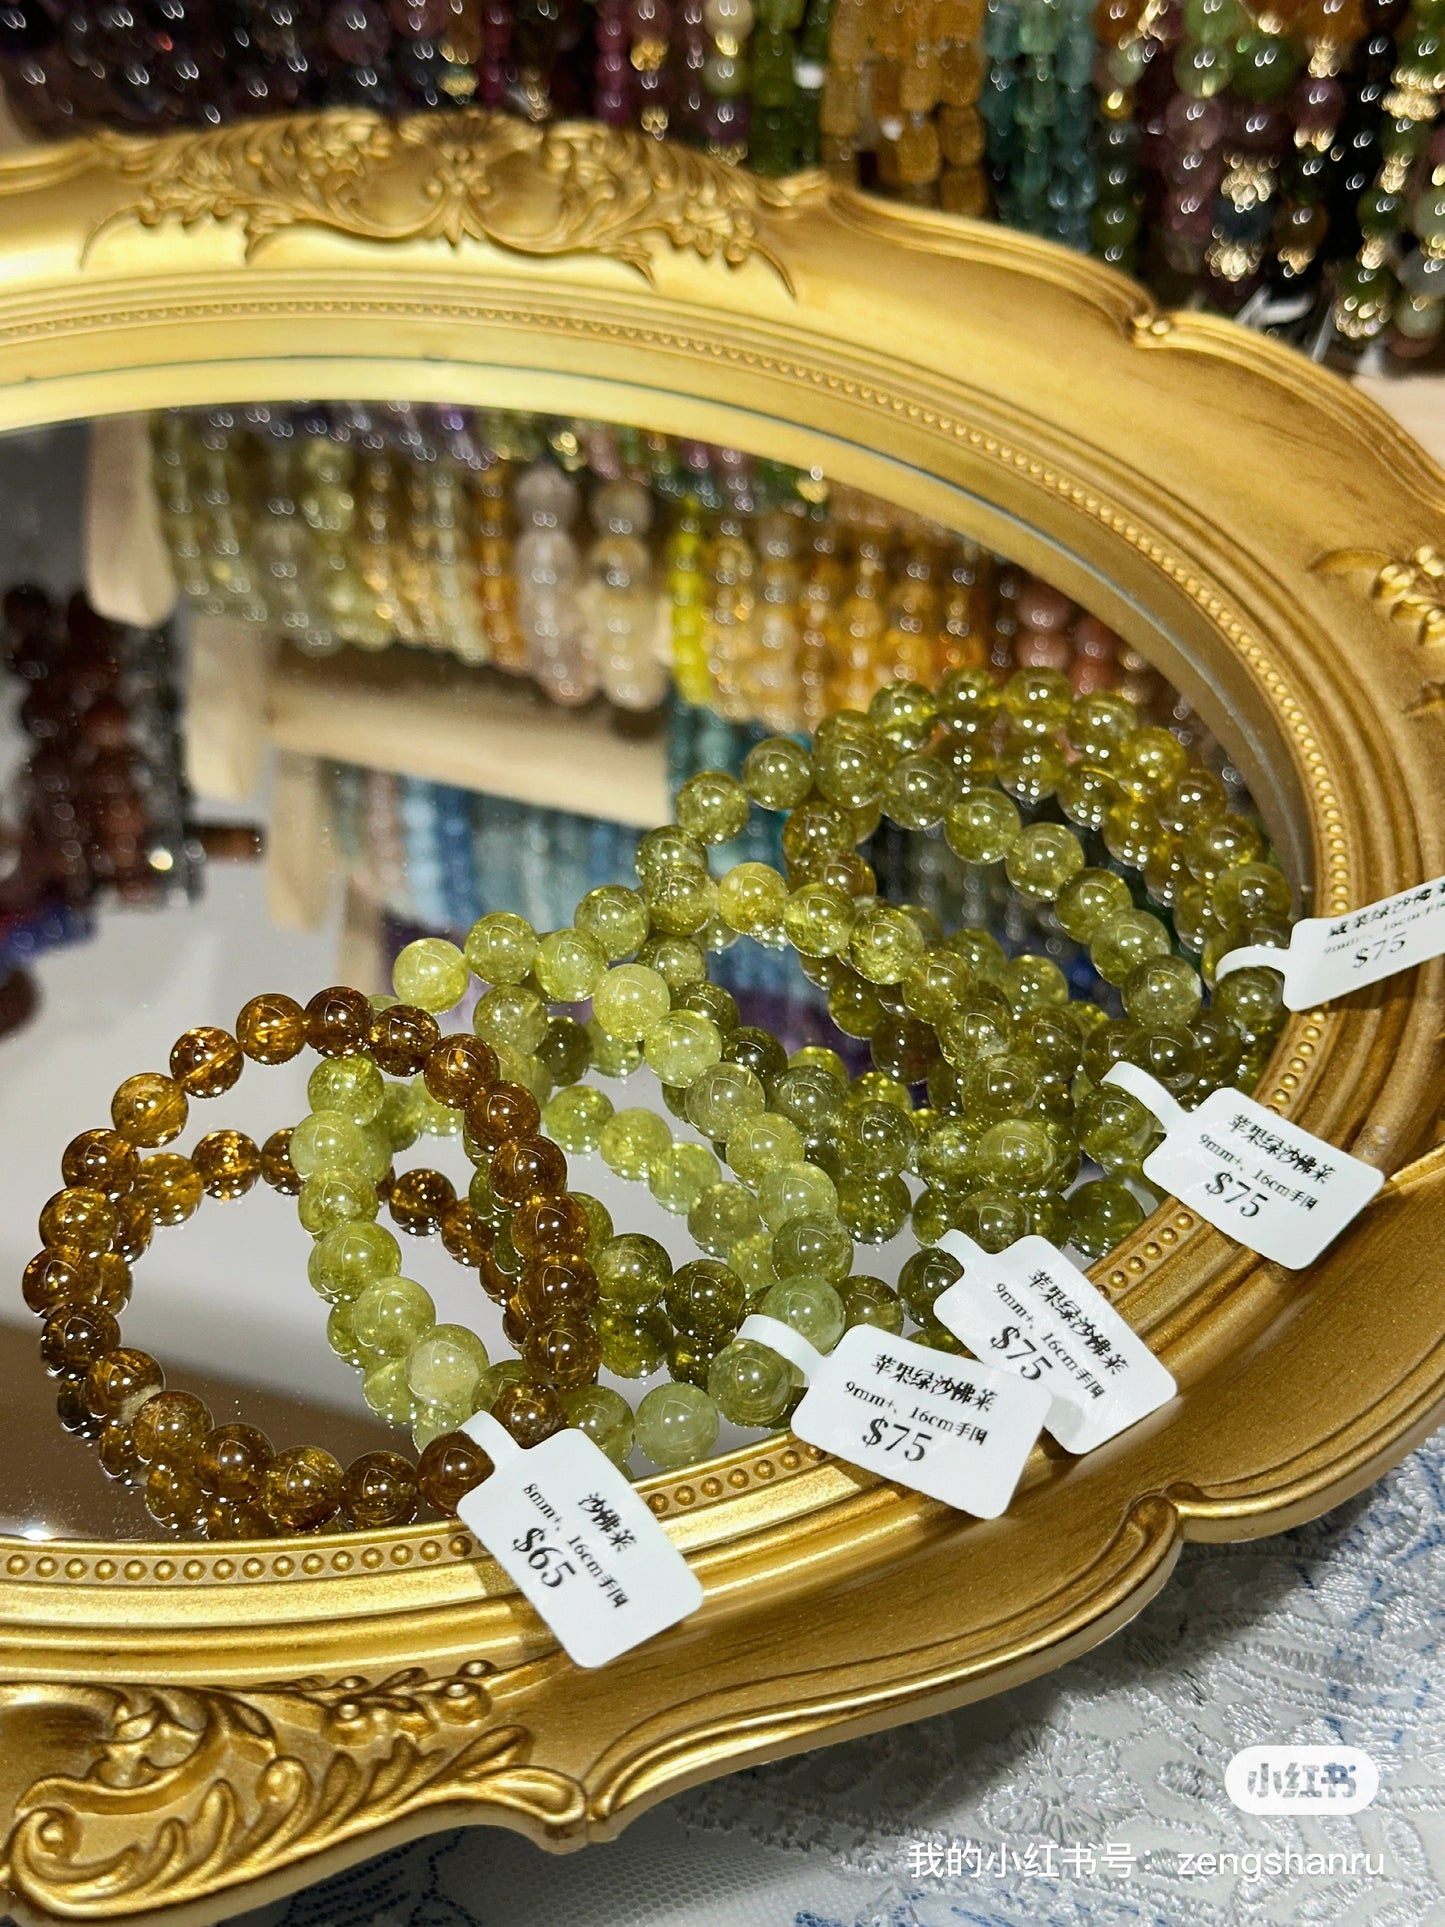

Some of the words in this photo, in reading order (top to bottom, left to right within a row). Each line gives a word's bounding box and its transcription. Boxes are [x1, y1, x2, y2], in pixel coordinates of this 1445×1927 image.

[1352, 932, 1407, 968] $75
[1205, 1170, 1268, 1217] $75
[990, 1325, 1053, 1380] $75
[862, 1416, 932, 1461] $75
[512, 1527, 577, 1588] $65
